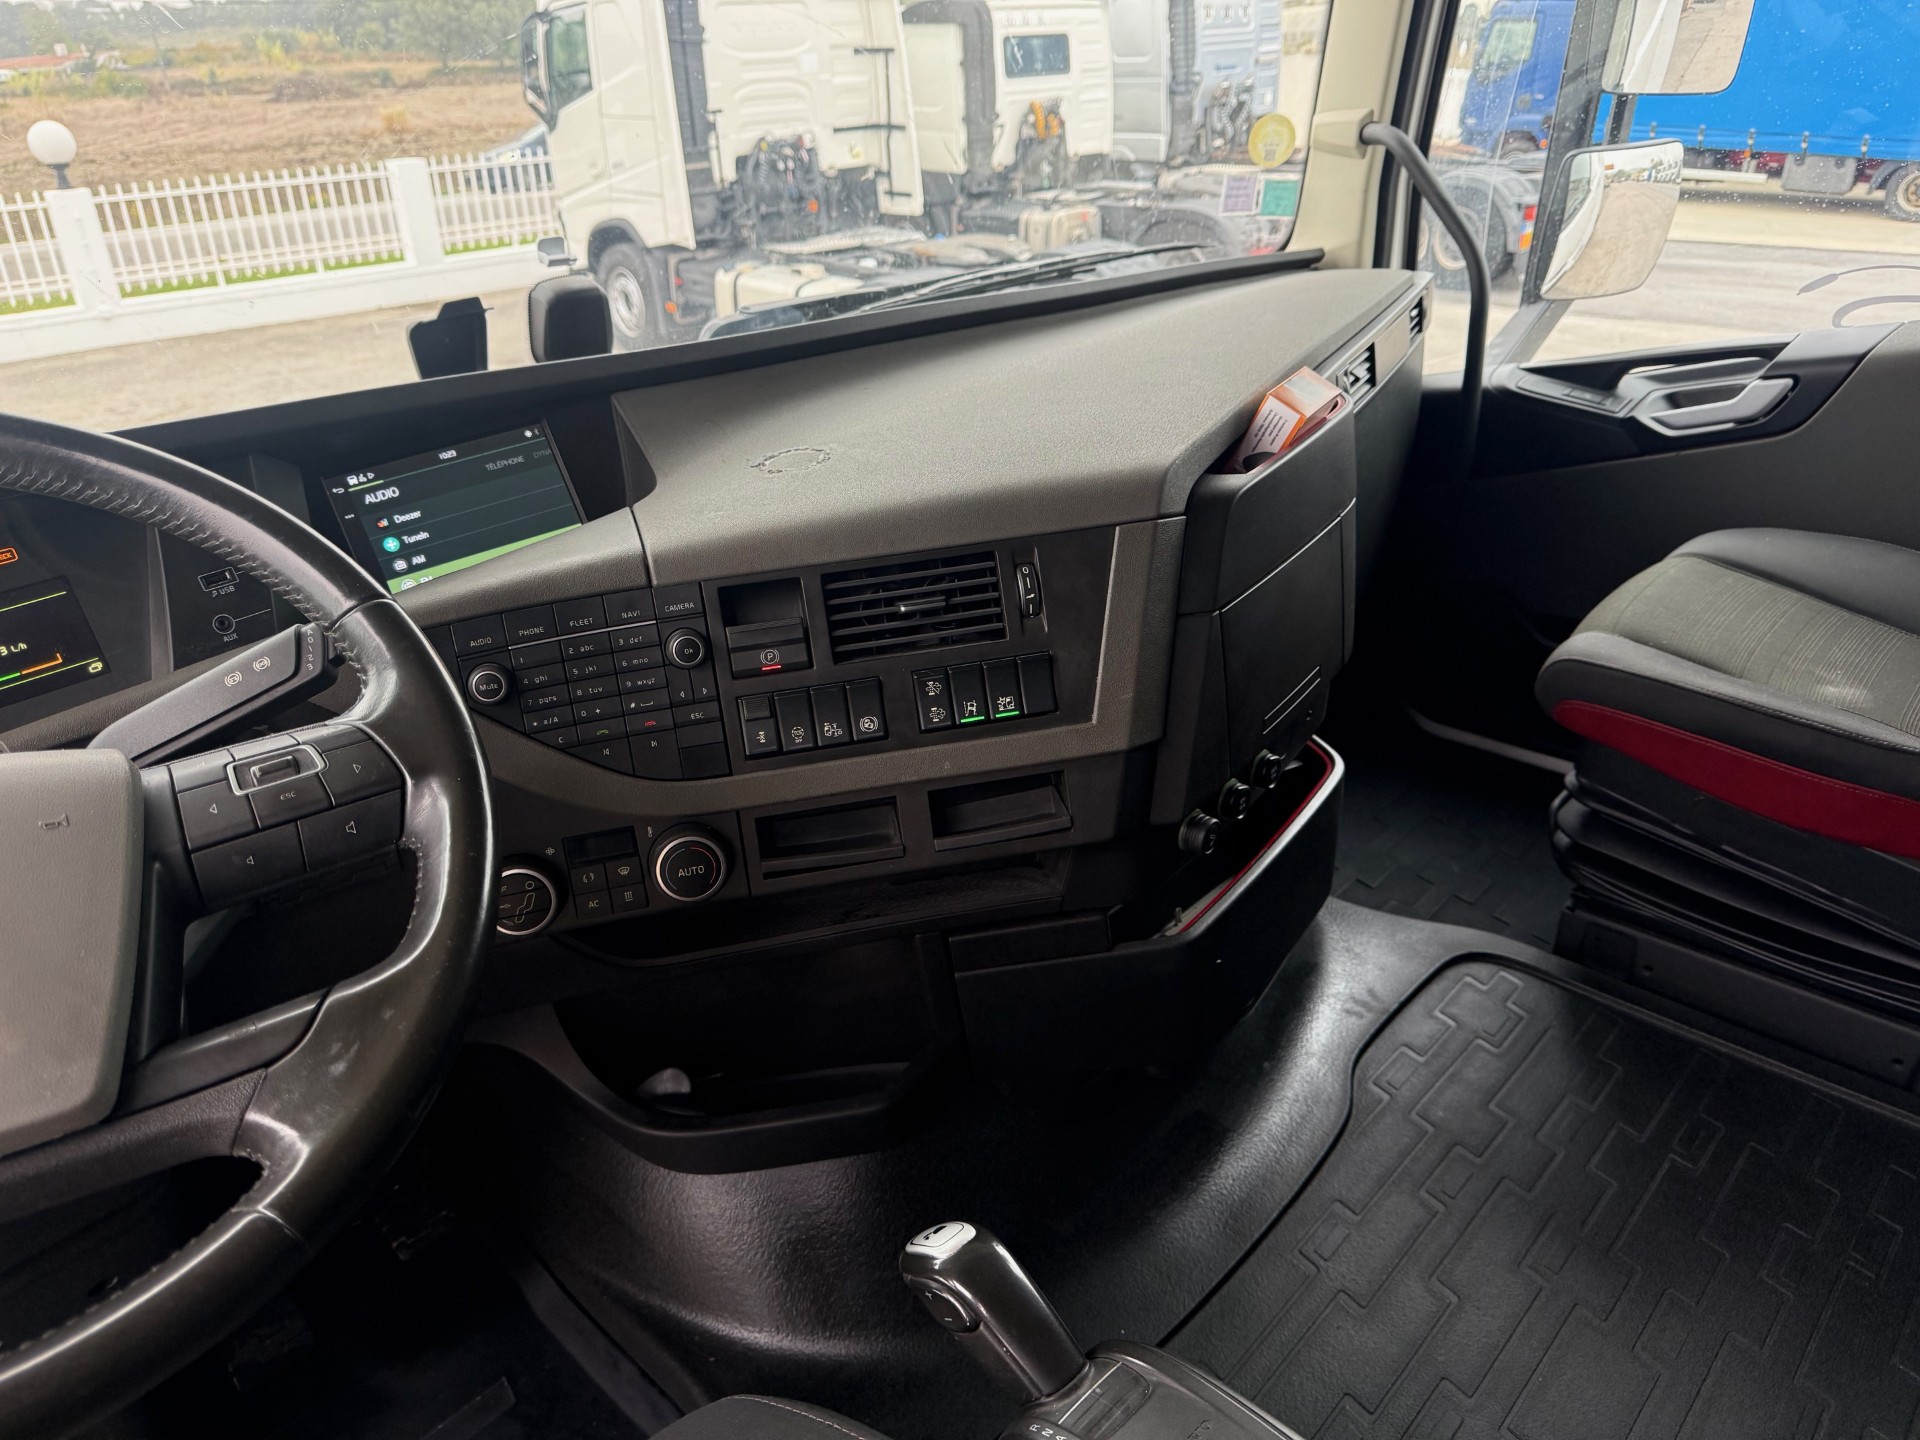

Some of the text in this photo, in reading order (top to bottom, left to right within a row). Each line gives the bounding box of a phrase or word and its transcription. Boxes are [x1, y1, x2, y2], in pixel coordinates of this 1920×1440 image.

[485, 455, 525, 471] TÉLÉPHONE
[364, 486, 400, 505] AUDIO
[393, 510, 421, 524] Deezer
[401, 531, 430, 544] TuneIn
[411, 554, 426, 566] AM
[219, 585, 236, 596] USB
[664, 601, 695, 613] CAMERA
[621, 610, 641, 619] NAVI
[569, 617, 594, 628] FLEET
[518, 626, 545, 637] PHONE
[223, 632, 239, 643] AUX
[470, 636, 492, 647] AUDIO
[629, 636, 643, 644] def
[580, 644, 595, 652] abc
[632, 657, 649, 665] mno
[585, 665, 597, 674] jkl
[534, 674, 548, 683] ghi
[637, 677, 656, 686] wxyz
[479, 682, 499, 692] Mute
[588, 686, 603, 694] tuv
[539, 695, 557, 704] pqrs
[690, 711, 705, 720] ESC
[558, 736, 564, 744] C
[280, 791, 297, 801] ESC
[677, 865, 705, 878] AUTO
[588, 900, 600, 909] AC
[1029, 1423, 1041, 1432] R
[1041, 1427, 1054, 1438] N
